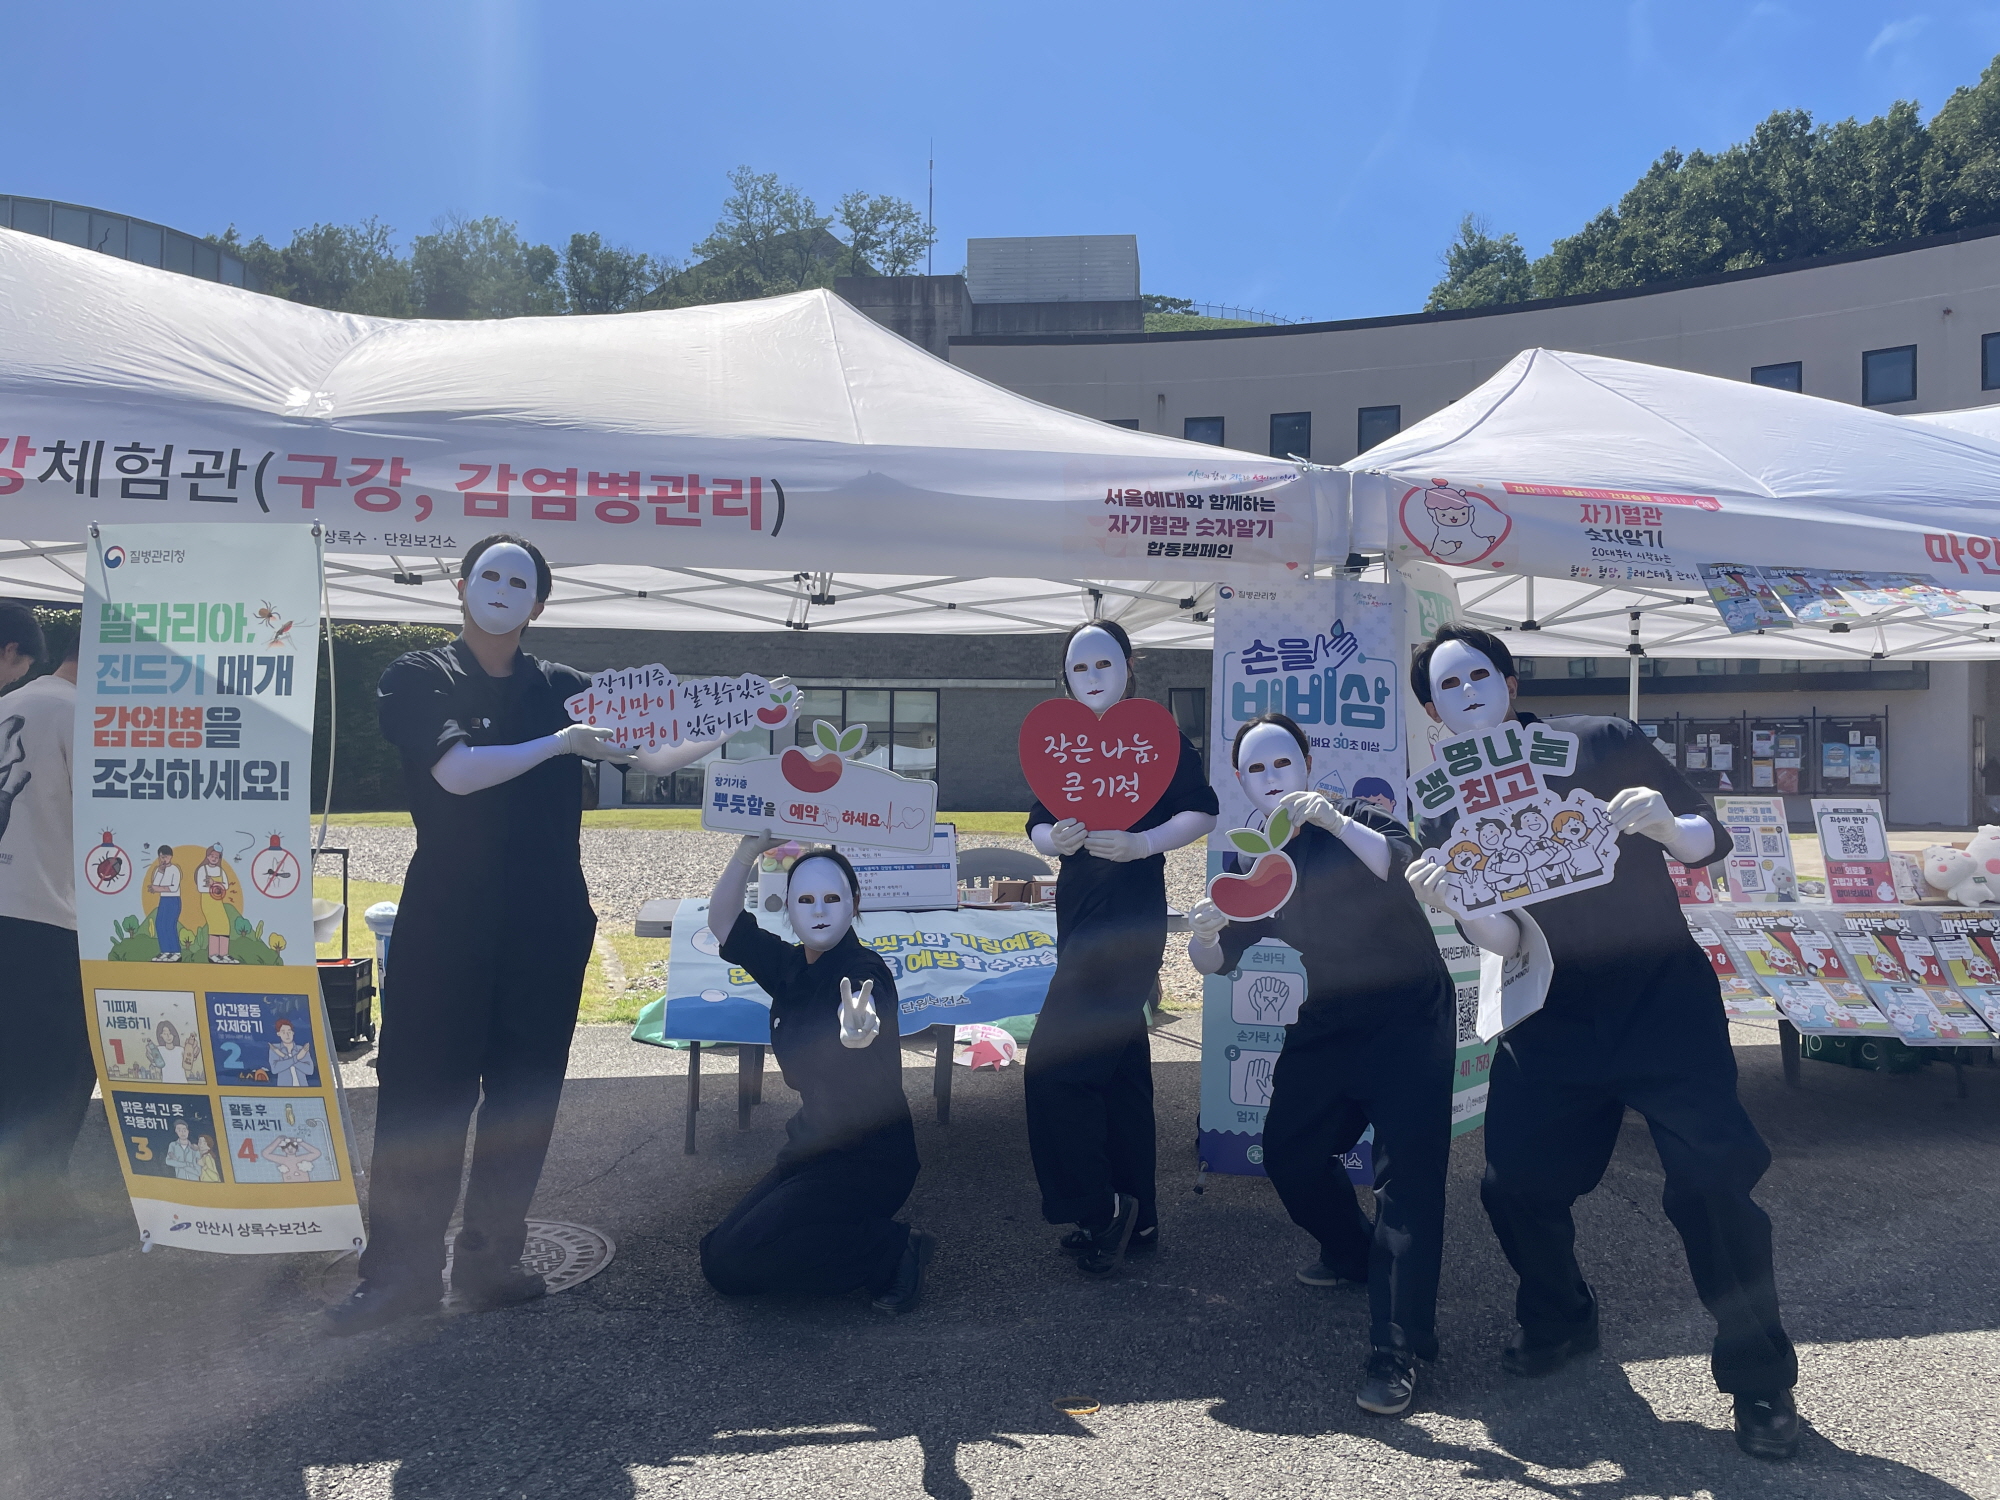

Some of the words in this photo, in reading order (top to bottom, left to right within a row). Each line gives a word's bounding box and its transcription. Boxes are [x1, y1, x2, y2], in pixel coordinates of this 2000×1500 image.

[454, 461, 786, 538] 감염병관리)
[1104, 488, 1204, 511] 서울예대와
[1208, 493, 1276, 512] 함께하는
[1580, 503, 1663, 527] 자기혈관
[1107, 514, 1190, 537] 자기혈관
[1195, 517, 1274, 539] 숫자알기
[381, 531, 457, 550] 단원보건소
[1584, 527, 1663, 549] 숫자알기
[129, 548, 186, 565] 질병관리청
[1146, 541, 1234, 559] 합동캠페인
[1591, 547, 1633, 558] 20대부터
[1636, 551, 1672, 564] 시작하는
[1598, 565, 1621, 579] 혈당,
[1626, 566, 1673, 581] 콜레스테롤
[1675, 570, 1699, 581] 관리!
[1237, 589, 1277, 601] 질병관리청
[100, 601, 256, 644] 말라리아,
[1241, 638, 1315, 676] 손을
[96, 653, 205, 695] 진드기
[217, 655, 294, 696] 매개
[597, 668, 672, 695] 장기기증,
[570, 688, 675, 726] 당신만이
[93, 706, 243, 749] 감염병을
[686, 709, 754, 737] 있습니다
[1044, 733, 1093, 764] 작은
[1101, 733, 1159, 764] 나눔,
[1333, 737, 1359, 751] 30초
[1360, 740, 1380, 753] 이상
[1414, 728, 1570, 810] 생명나눔
[91, 758, 290, 801] 조심하세요!
[714, 775, 748, 789] 장기기증
[1062, 772, 1085, 802] 큰
[1091, 772, 1140, 803] 기적
[1459, 763, 1539, 815] 최고
[712, 792, 776, 818] 뿌듯함을
[789, 803, 820, 823] 예약
[841, 809, 882, 828] 하세요
[1735, 916, 1778, 929] 마인두
[1844, 917, 1885, 931] 마인두
[1941, 919, 1981, 933] 마인두
[907, 950, 987, 972] 예방할
[989, 959, 1010, 971] 수
[1251, 951, 1286, 965] 손바닥
[103, 1000, 138, 1014] 기피제
[214, 1003, 261, 1018] 야간활동
[901, 994, 972, 1014] 단원보건소
[106, 1016, 151, 1030] 사용하기
[215, 1020, 264, 1034] 자제하기
[1236, 1030, 1271, 1044] 손가락
[109, 1039, 126, 1065] 1
[220, 1041, 245, 1069] 2
[1229, 1049, 1236, 1057] 5
[121, 1101, 145, 1115] 밝은
[145, 1102, 157, 1116] 색
[157, 1103, 171, 1117] 긴
[171, 1104, 184, 1117] 옷
[228, 1103, 254, 1117] 활동
[255, 1104, 268, 1117] 후
[1236, 1110, 1259, 1124] 엄지
[124, 1115, 168, 1131] 착용하기
[231, 1118, 256, 1132] 즉시
[257, 1119, 282, 1132] 씻기
[131, 1136, 153, 1161] 3
[237, 1137, 259, 1163] 4
[195, 1220, 234, 1237] 안산시
[237, 1221, 322, 1237] 상록수보건소
